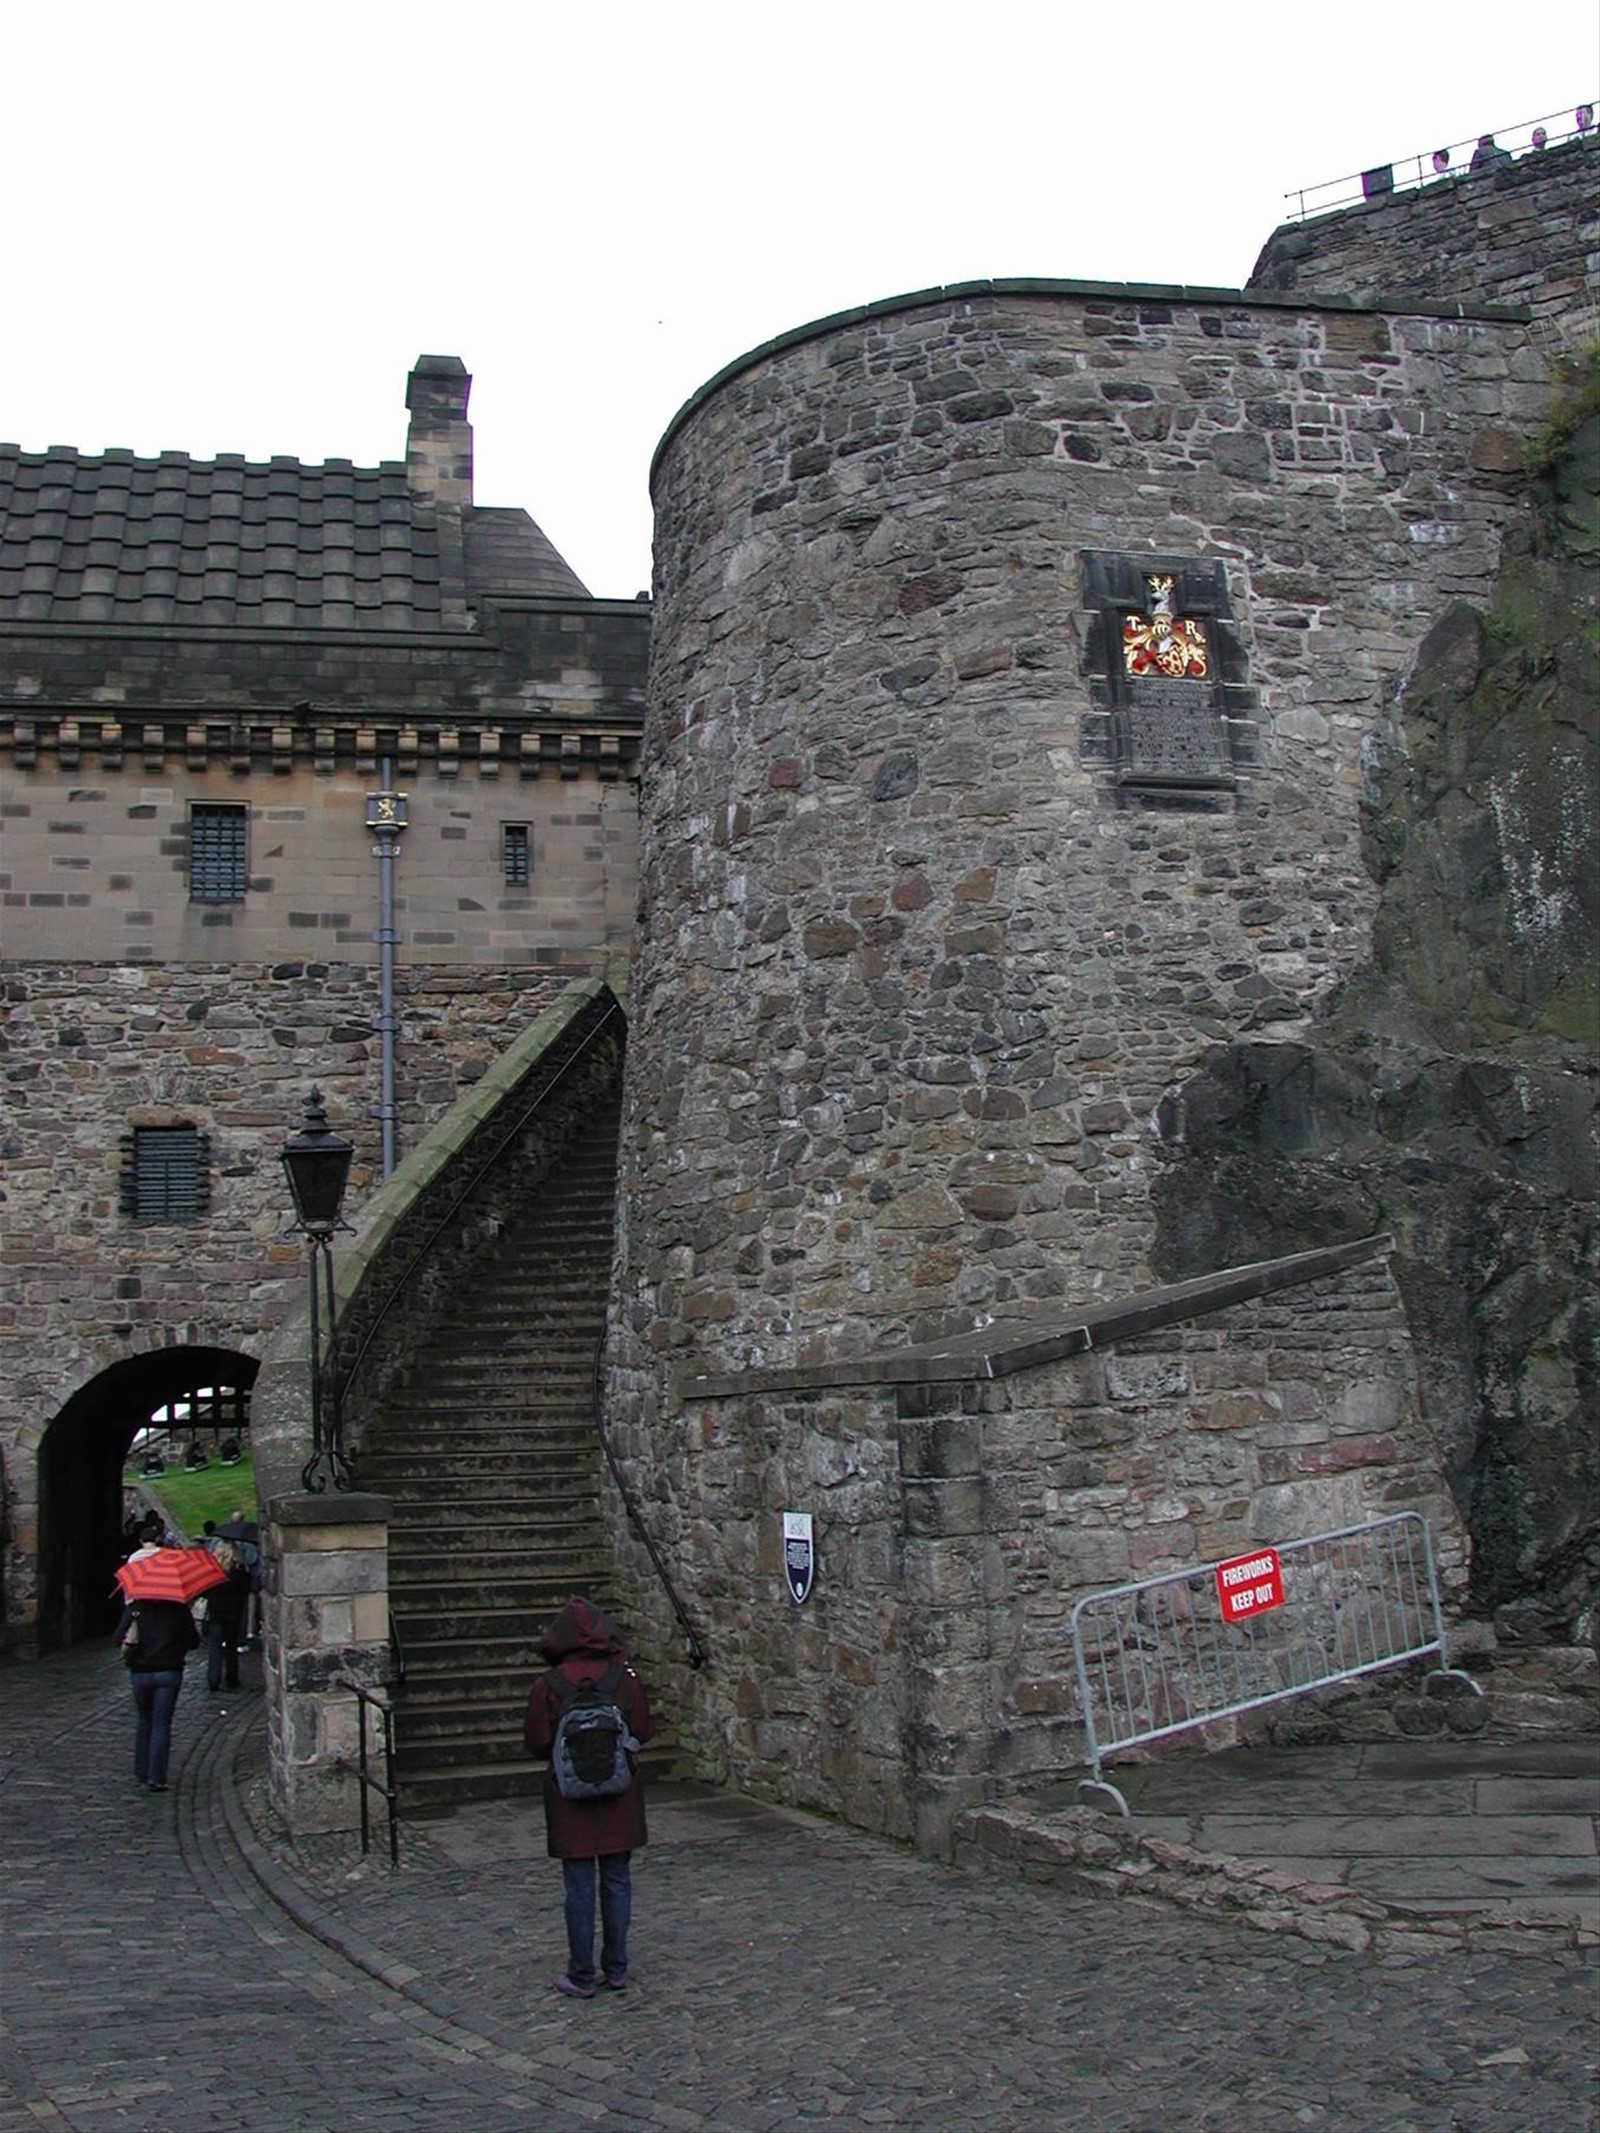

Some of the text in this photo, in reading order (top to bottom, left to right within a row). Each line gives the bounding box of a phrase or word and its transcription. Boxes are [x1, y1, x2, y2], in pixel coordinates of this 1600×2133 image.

[1222, 1556, 1274, 1587] FIREWORKS
[1231, 1583, 1273, 1612] KEEP OUT
